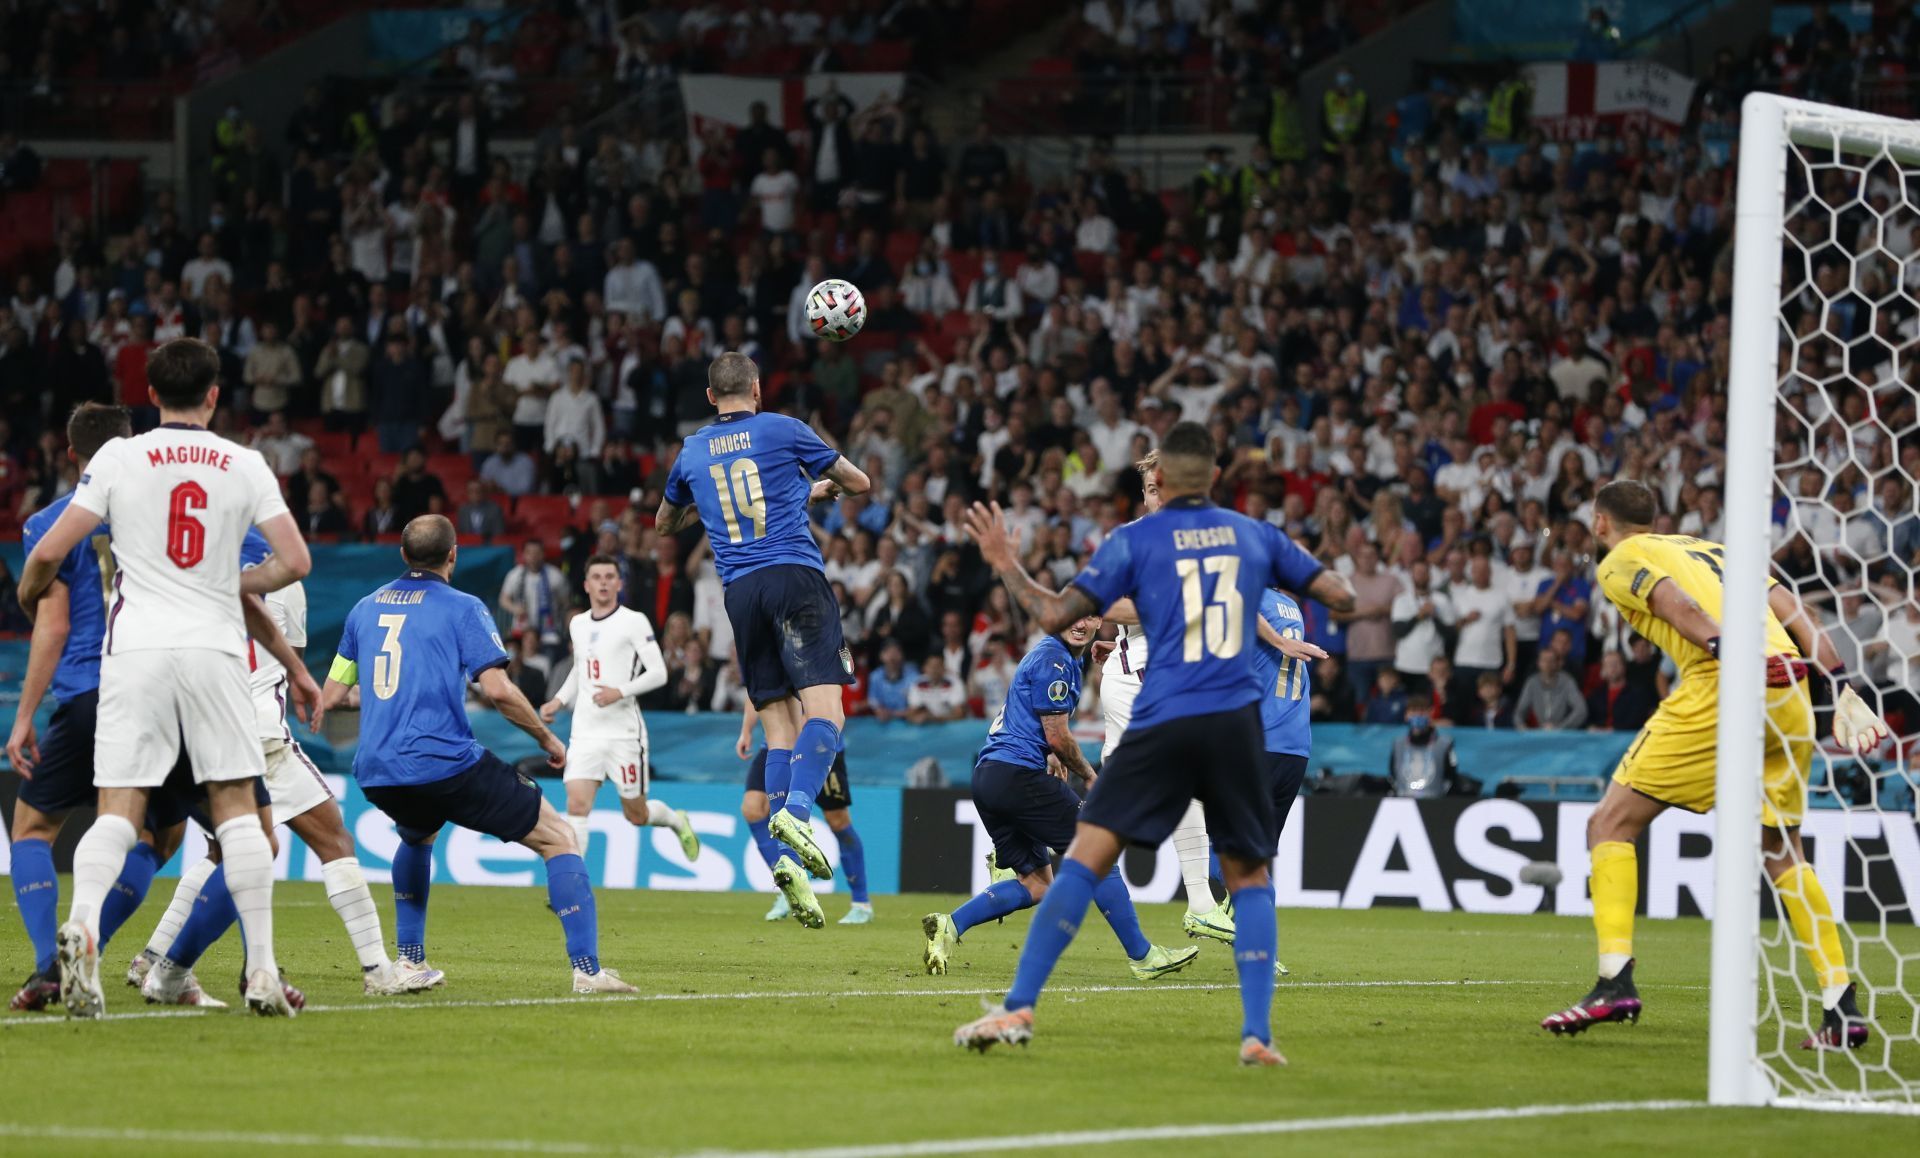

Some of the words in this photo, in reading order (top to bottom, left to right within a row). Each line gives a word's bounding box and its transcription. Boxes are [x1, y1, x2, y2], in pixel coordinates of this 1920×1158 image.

[709, 433, 751, 457] BONUCCI
[147, 446, 234, 472] MAGUIRE
[709, 458, 767, 544] 19
[166, 480, 208, 569] 6
[1174, 526, 1238, 550] EMERSON
[375, 589, 427, 605] CHIELLINI
[1175, 555, 1245, 663] 13
[373, 614, 407, 700] 3
[586, 659, 600, 680] 19
[1275, 627, 1303, 701] 11
[621, 763, 637, 784] 19
[823, 771, 842, 796] 14
[180, 773, 840, 894] sense
